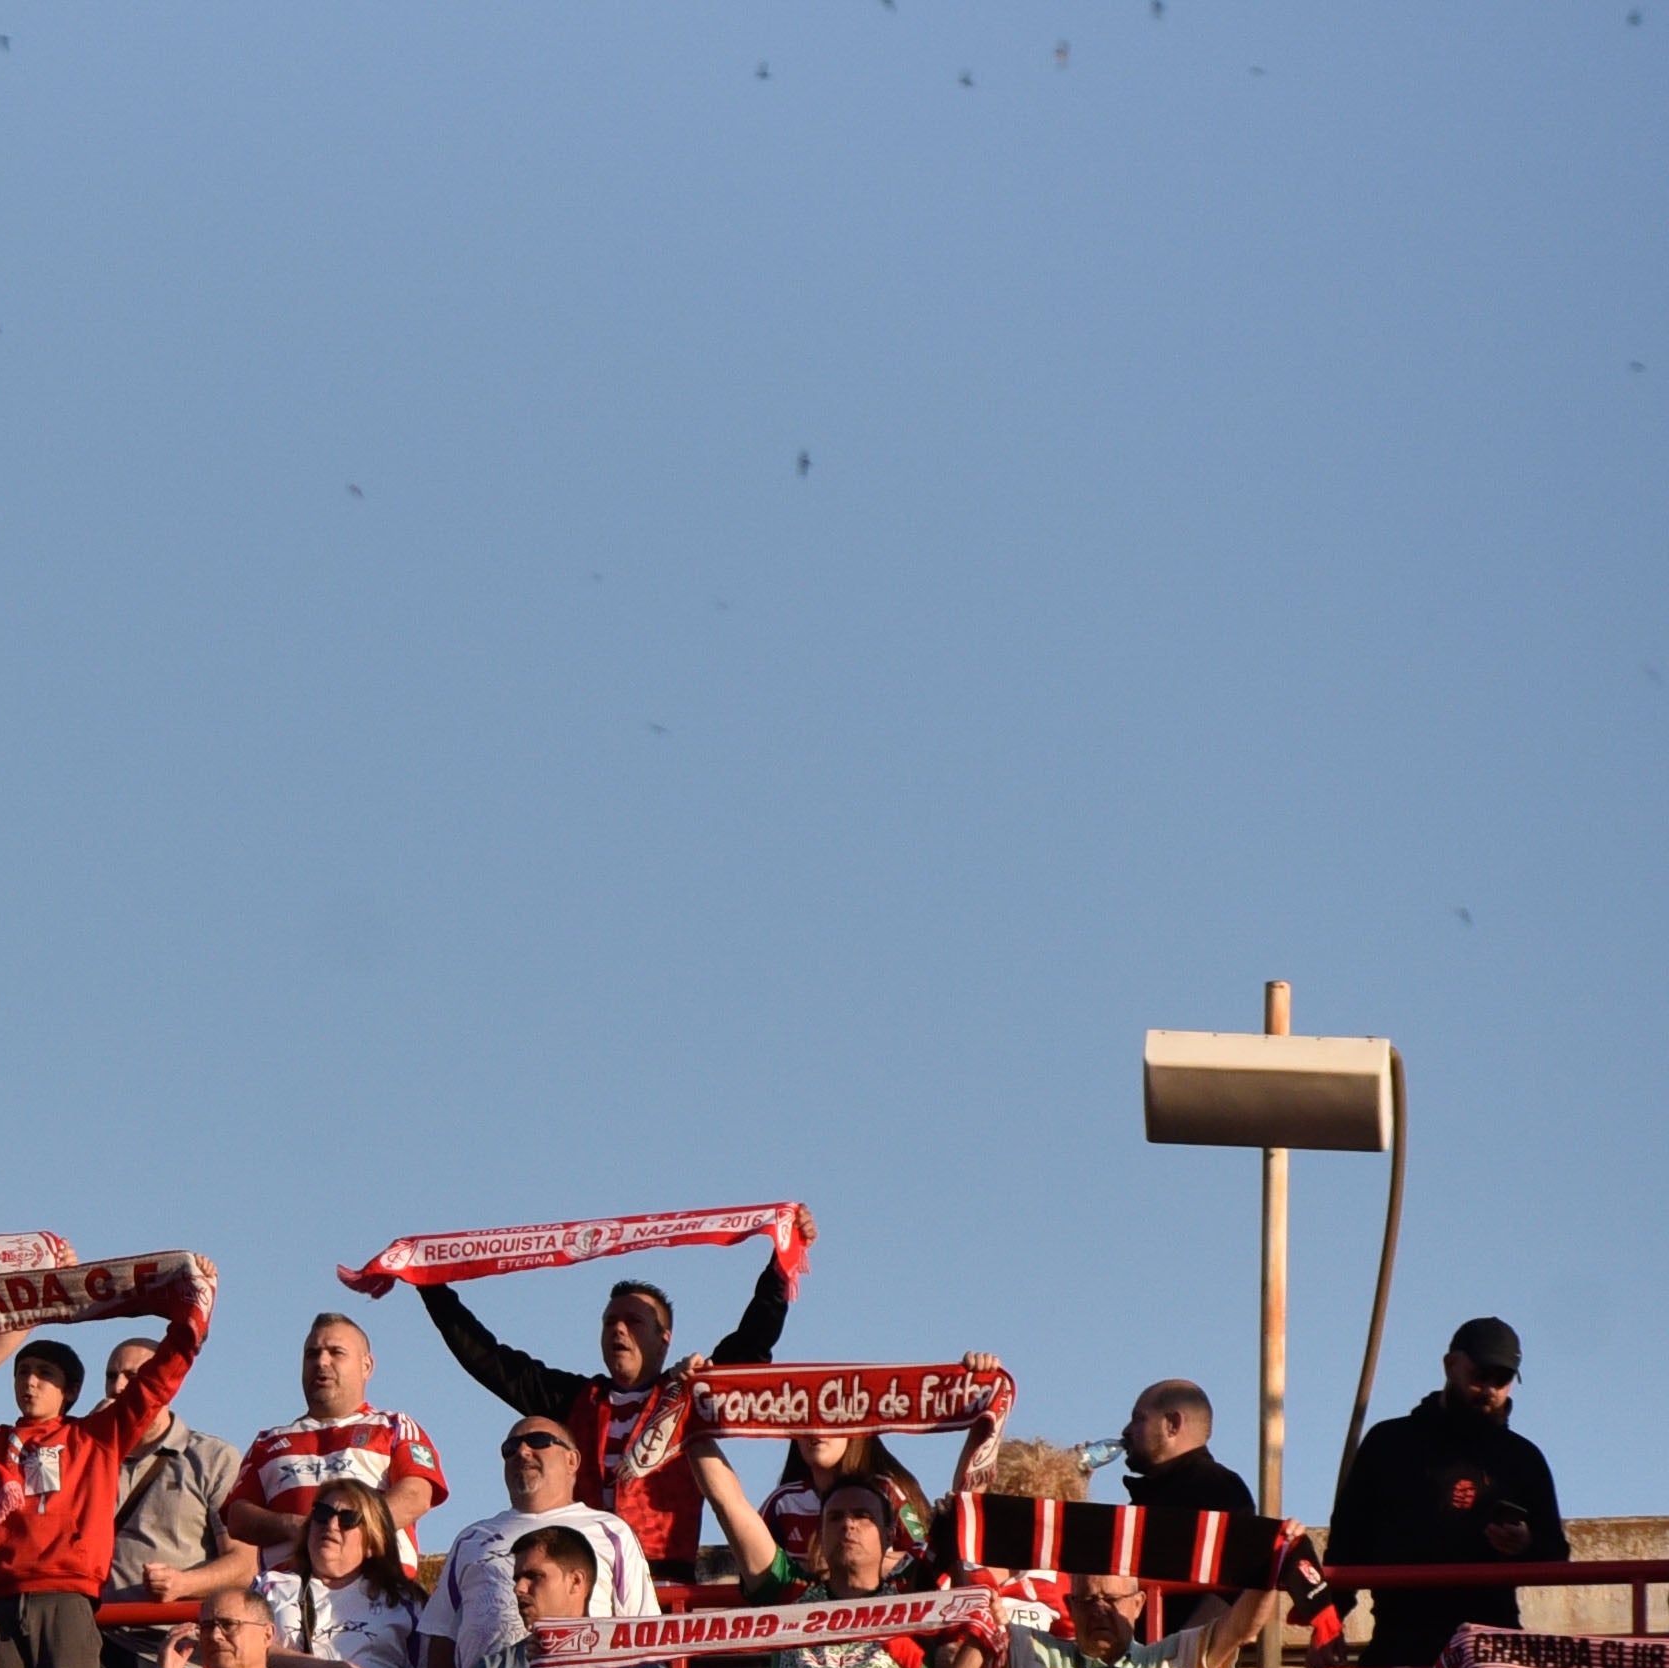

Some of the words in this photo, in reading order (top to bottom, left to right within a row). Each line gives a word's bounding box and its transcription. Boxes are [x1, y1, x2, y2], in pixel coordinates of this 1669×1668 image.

[424, 1235, 557, 1262] RECONQUISTA
[721, 1214, 763, 1230] 2016
[692, 1382, 811, 1426] Granada
[819, 1377, 871, 1423] Club
[880, 1385, 911, 1421] de
